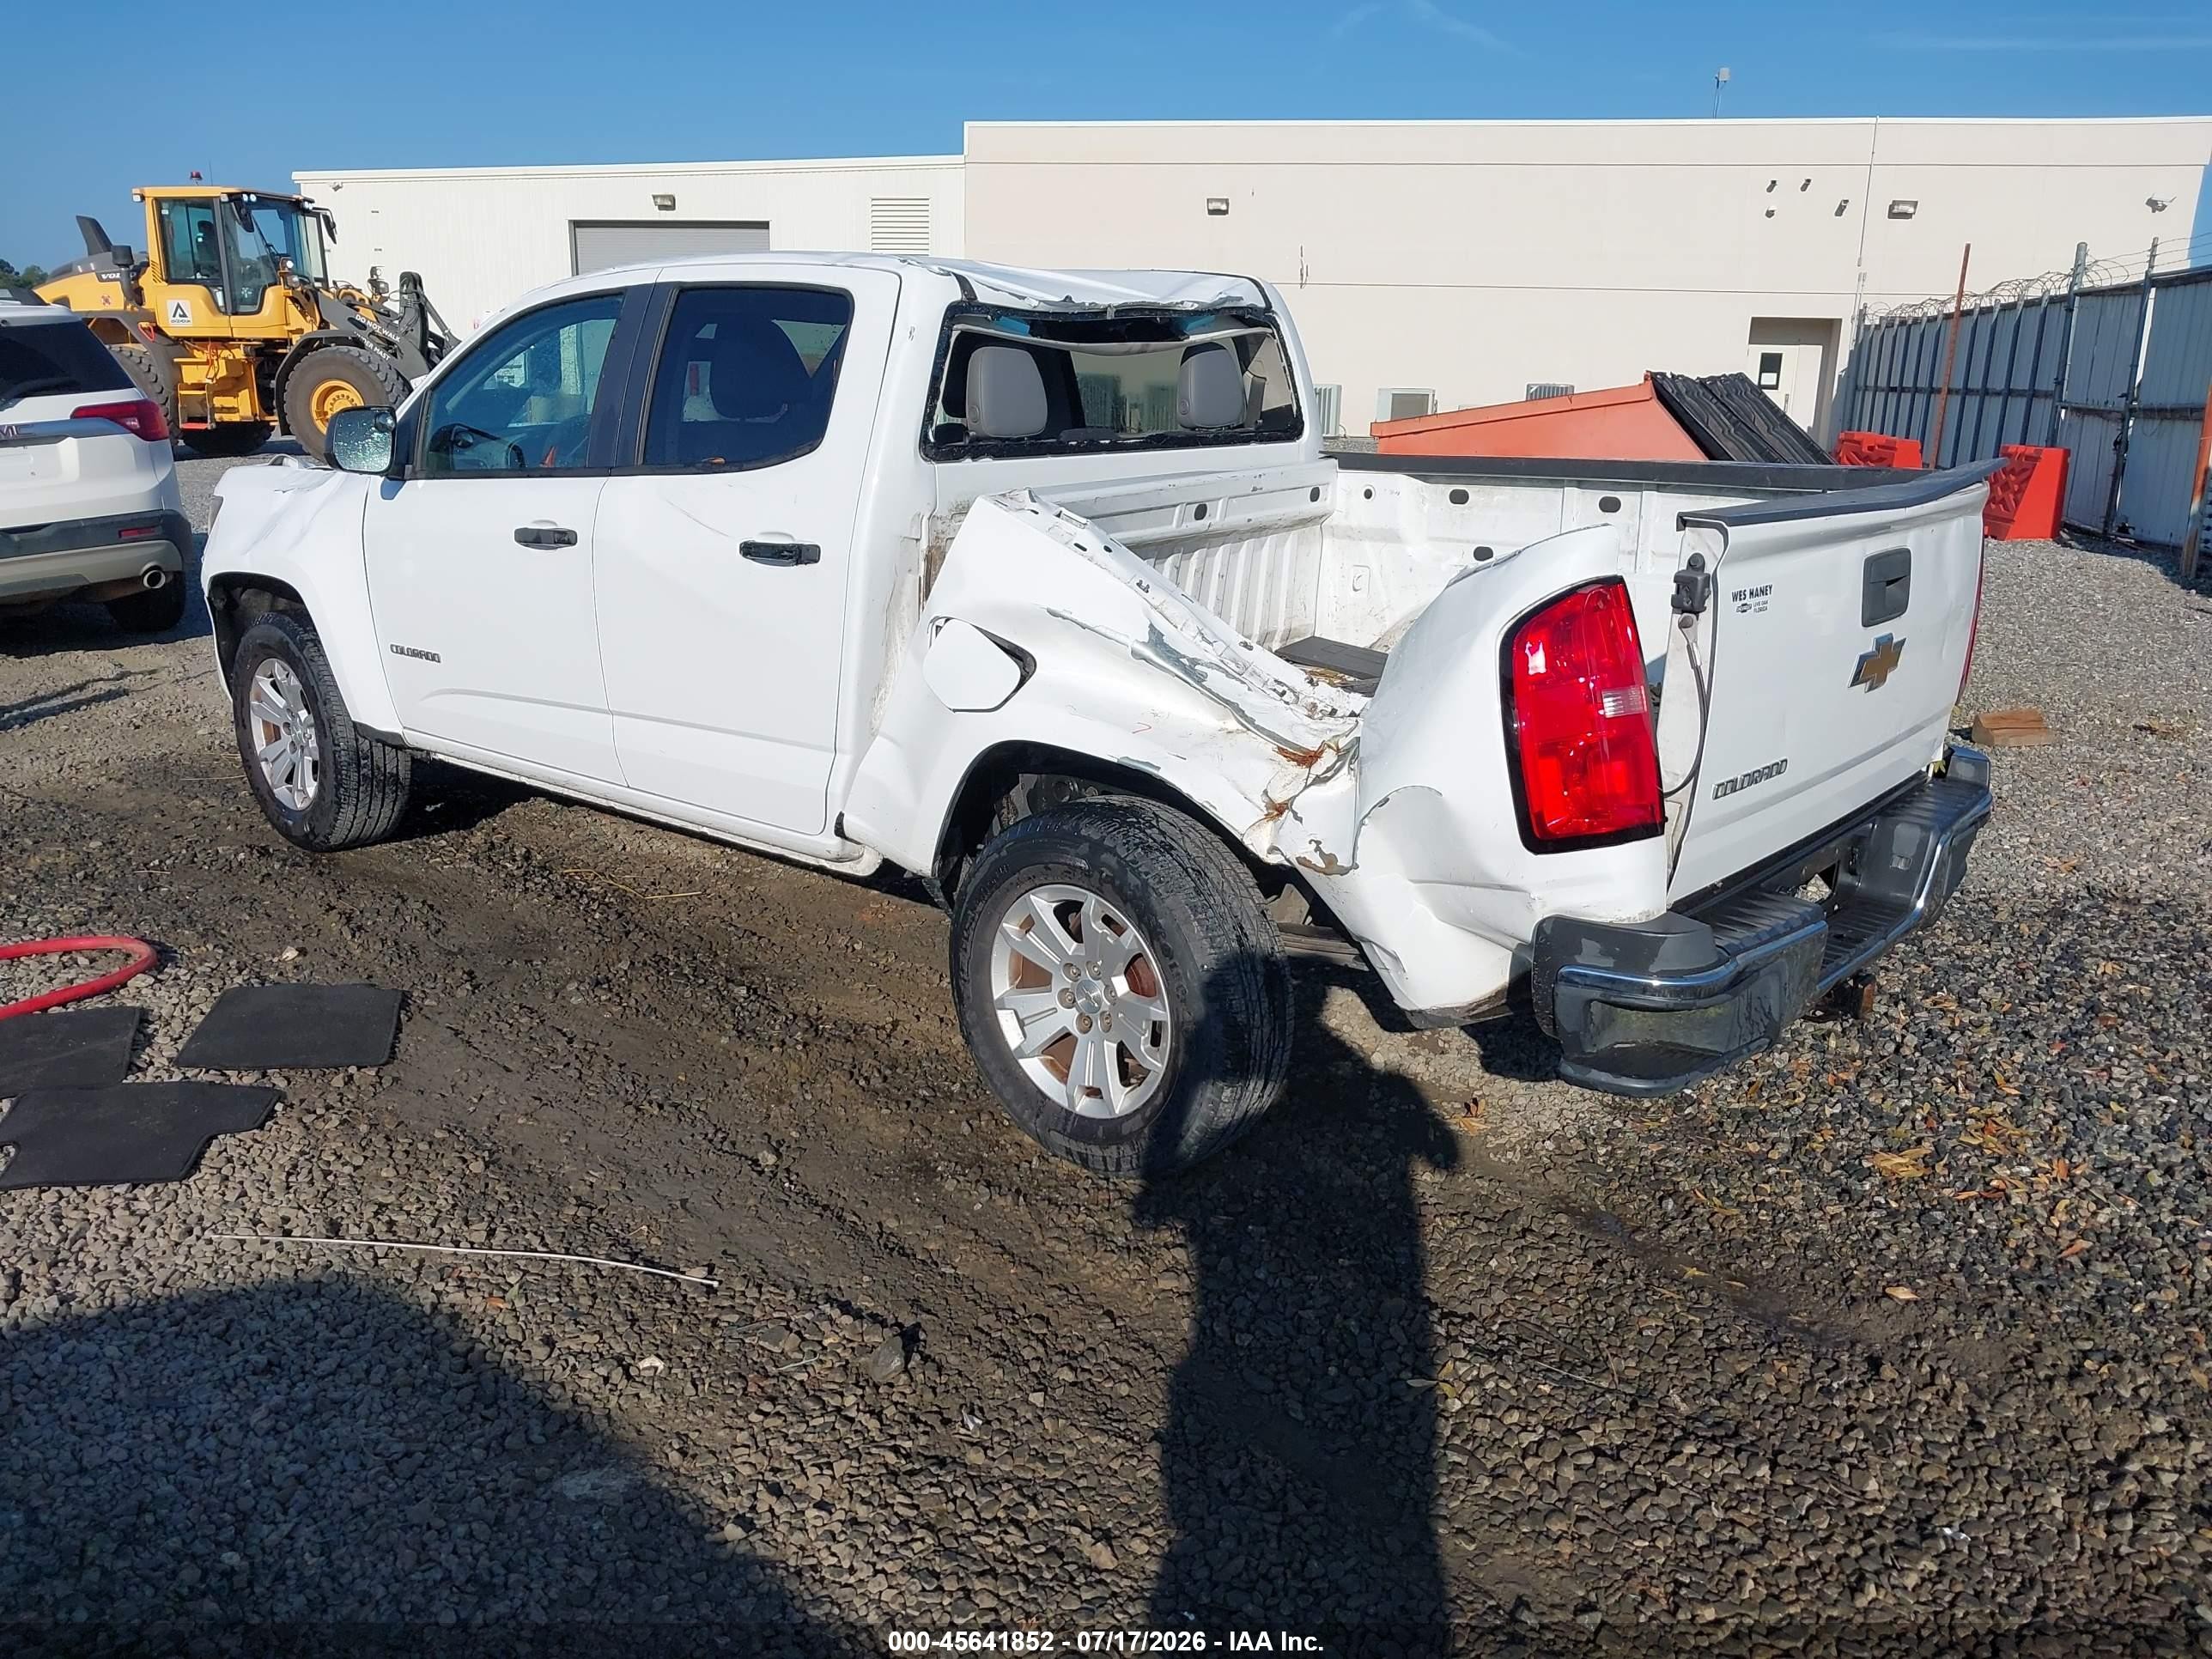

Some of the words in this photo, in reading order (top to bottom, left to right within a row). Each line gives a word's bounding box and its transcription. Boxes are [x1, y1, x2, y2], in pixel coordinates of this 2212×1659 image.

[356, 313, 366, 325] DO
[367, 320, 382, 333] NOT
[382, 328, 401, 342] WALK
[374, 347, 391, 361] MAST
[1731, 589, 1747, 603] WES
[1748, 584, 1773, 599] HANEY
[389, 643, 441, 663] COLORADO
[1711, 758, 1788, 800] COLORADO
